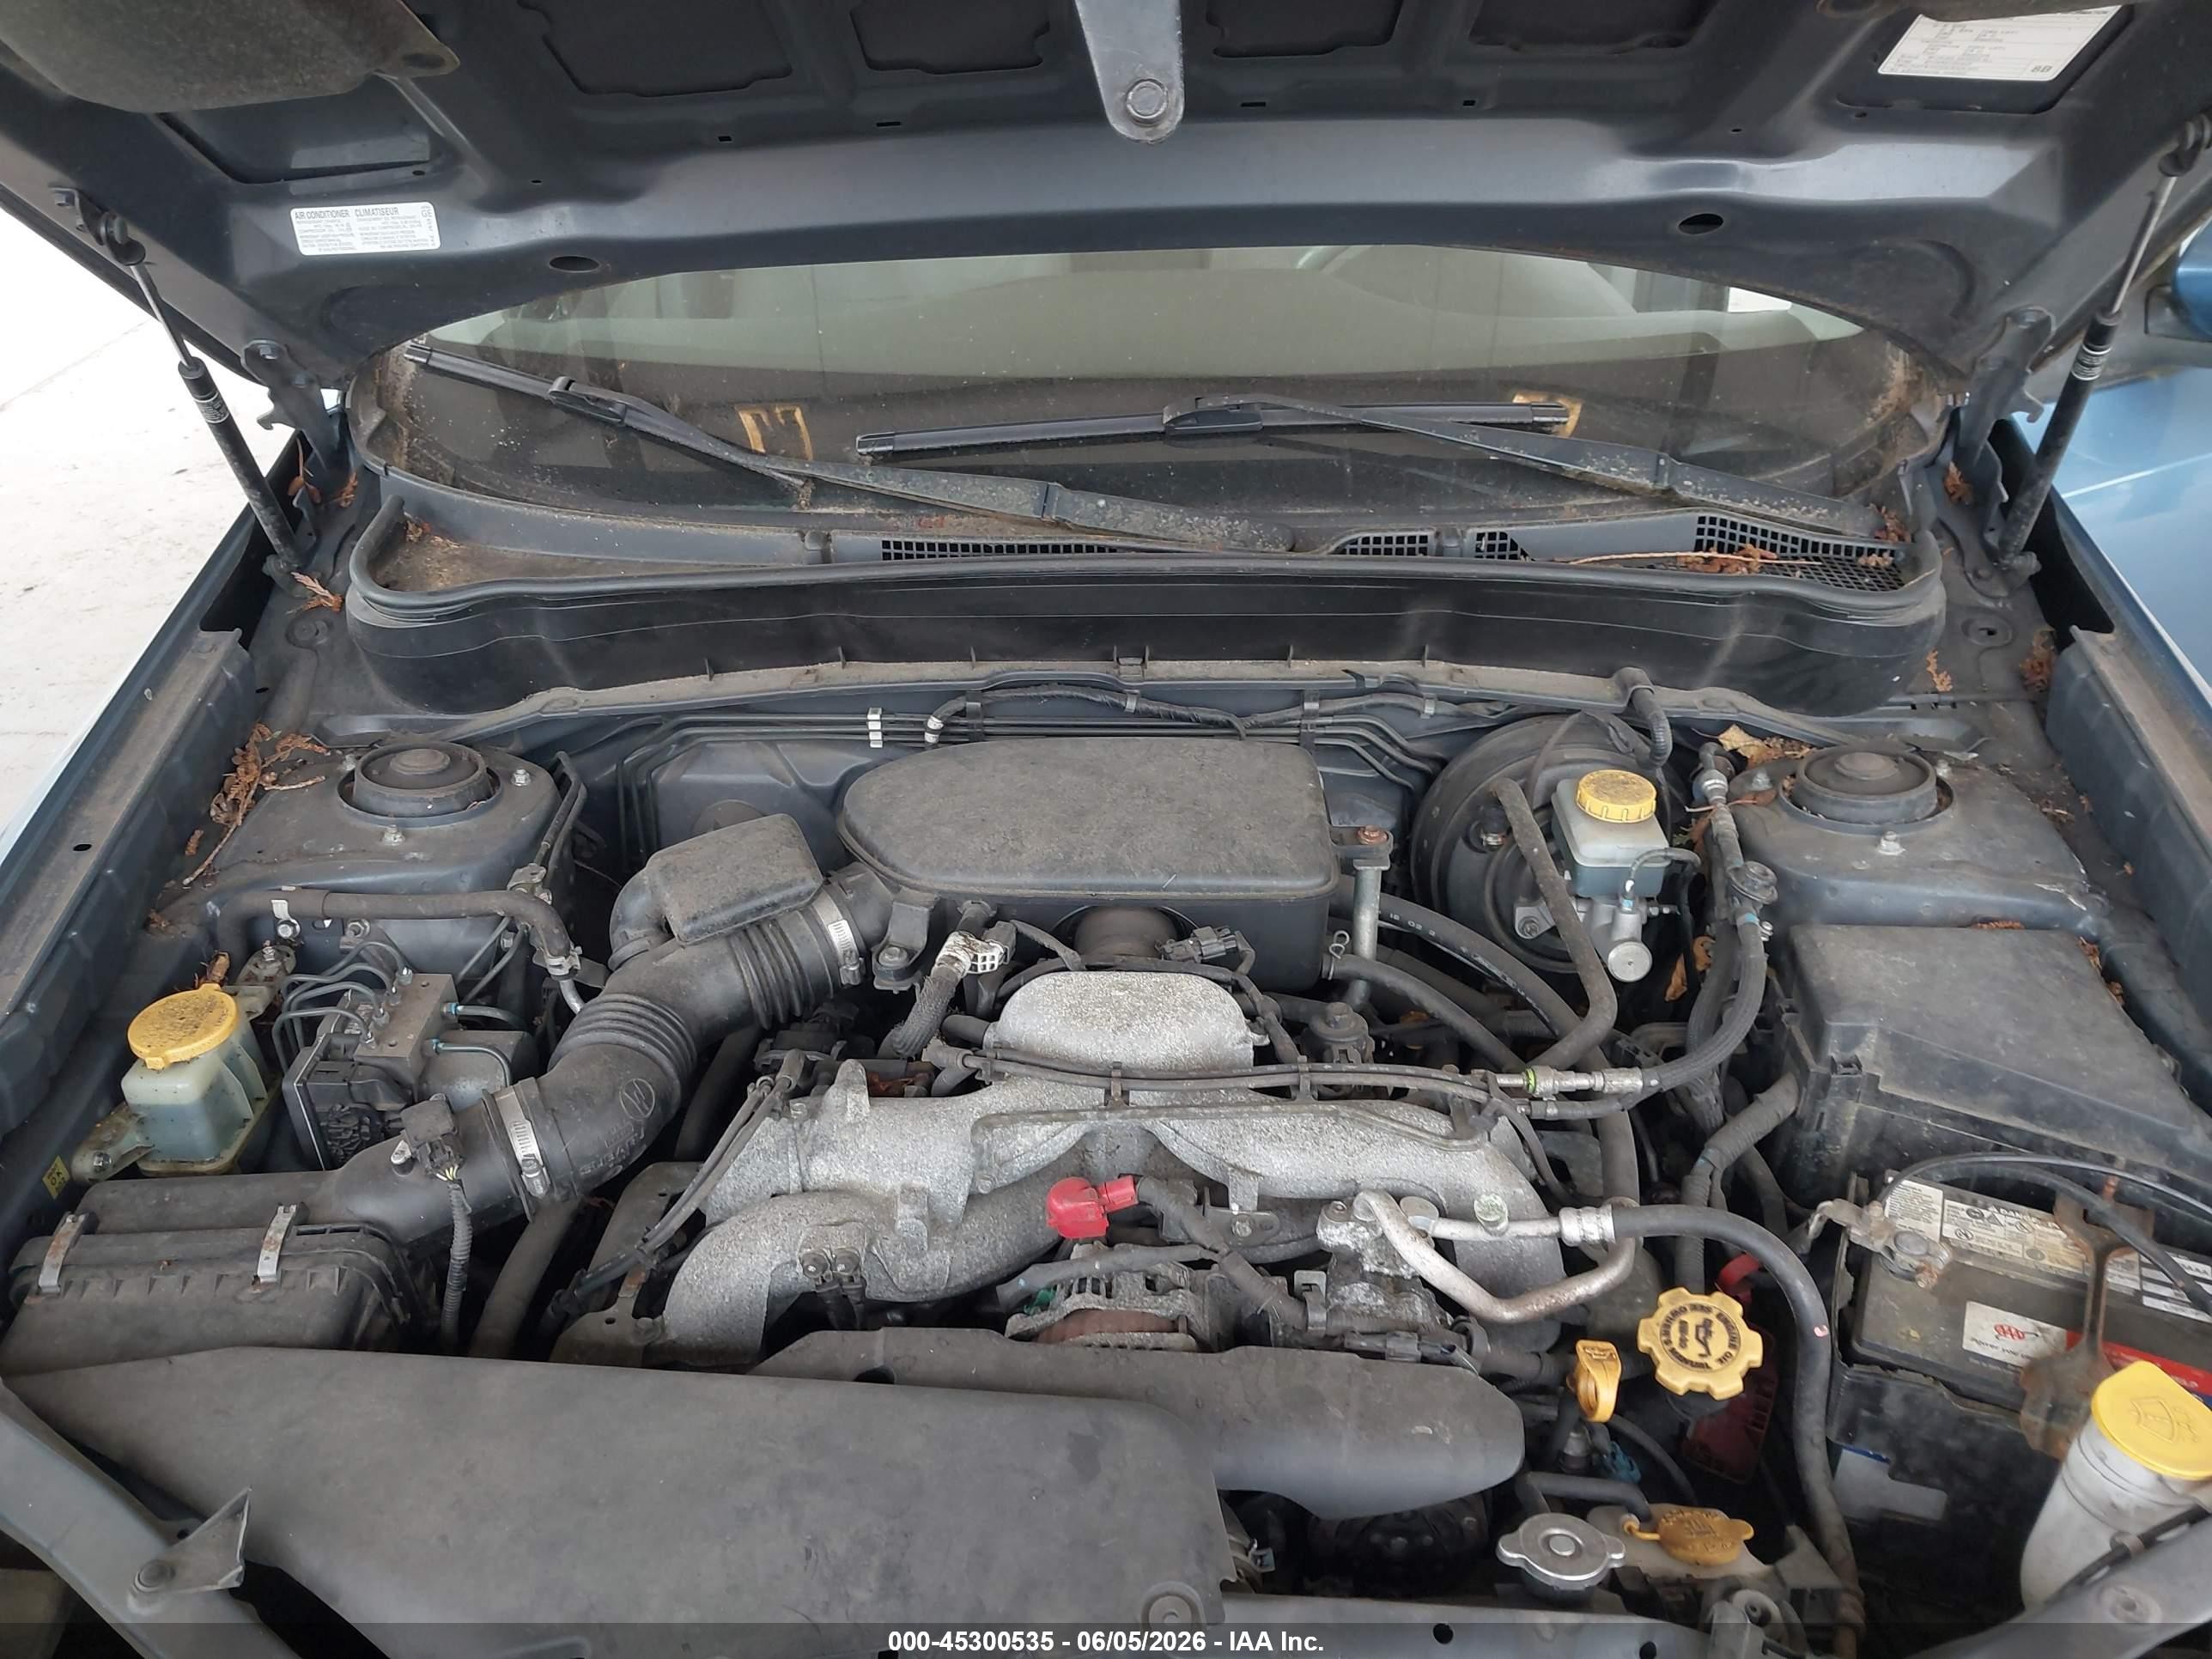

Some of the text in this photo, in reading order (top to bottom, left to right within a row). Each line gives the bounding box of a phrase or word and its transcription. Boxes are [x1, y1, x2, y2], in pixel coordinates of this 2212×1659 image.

[295, 210, 350, 220] AIR CONDITIONER
[355, 207, 399, 216] CLIMATISEUR
[1717, 1351, 1733, 1365] OIL
